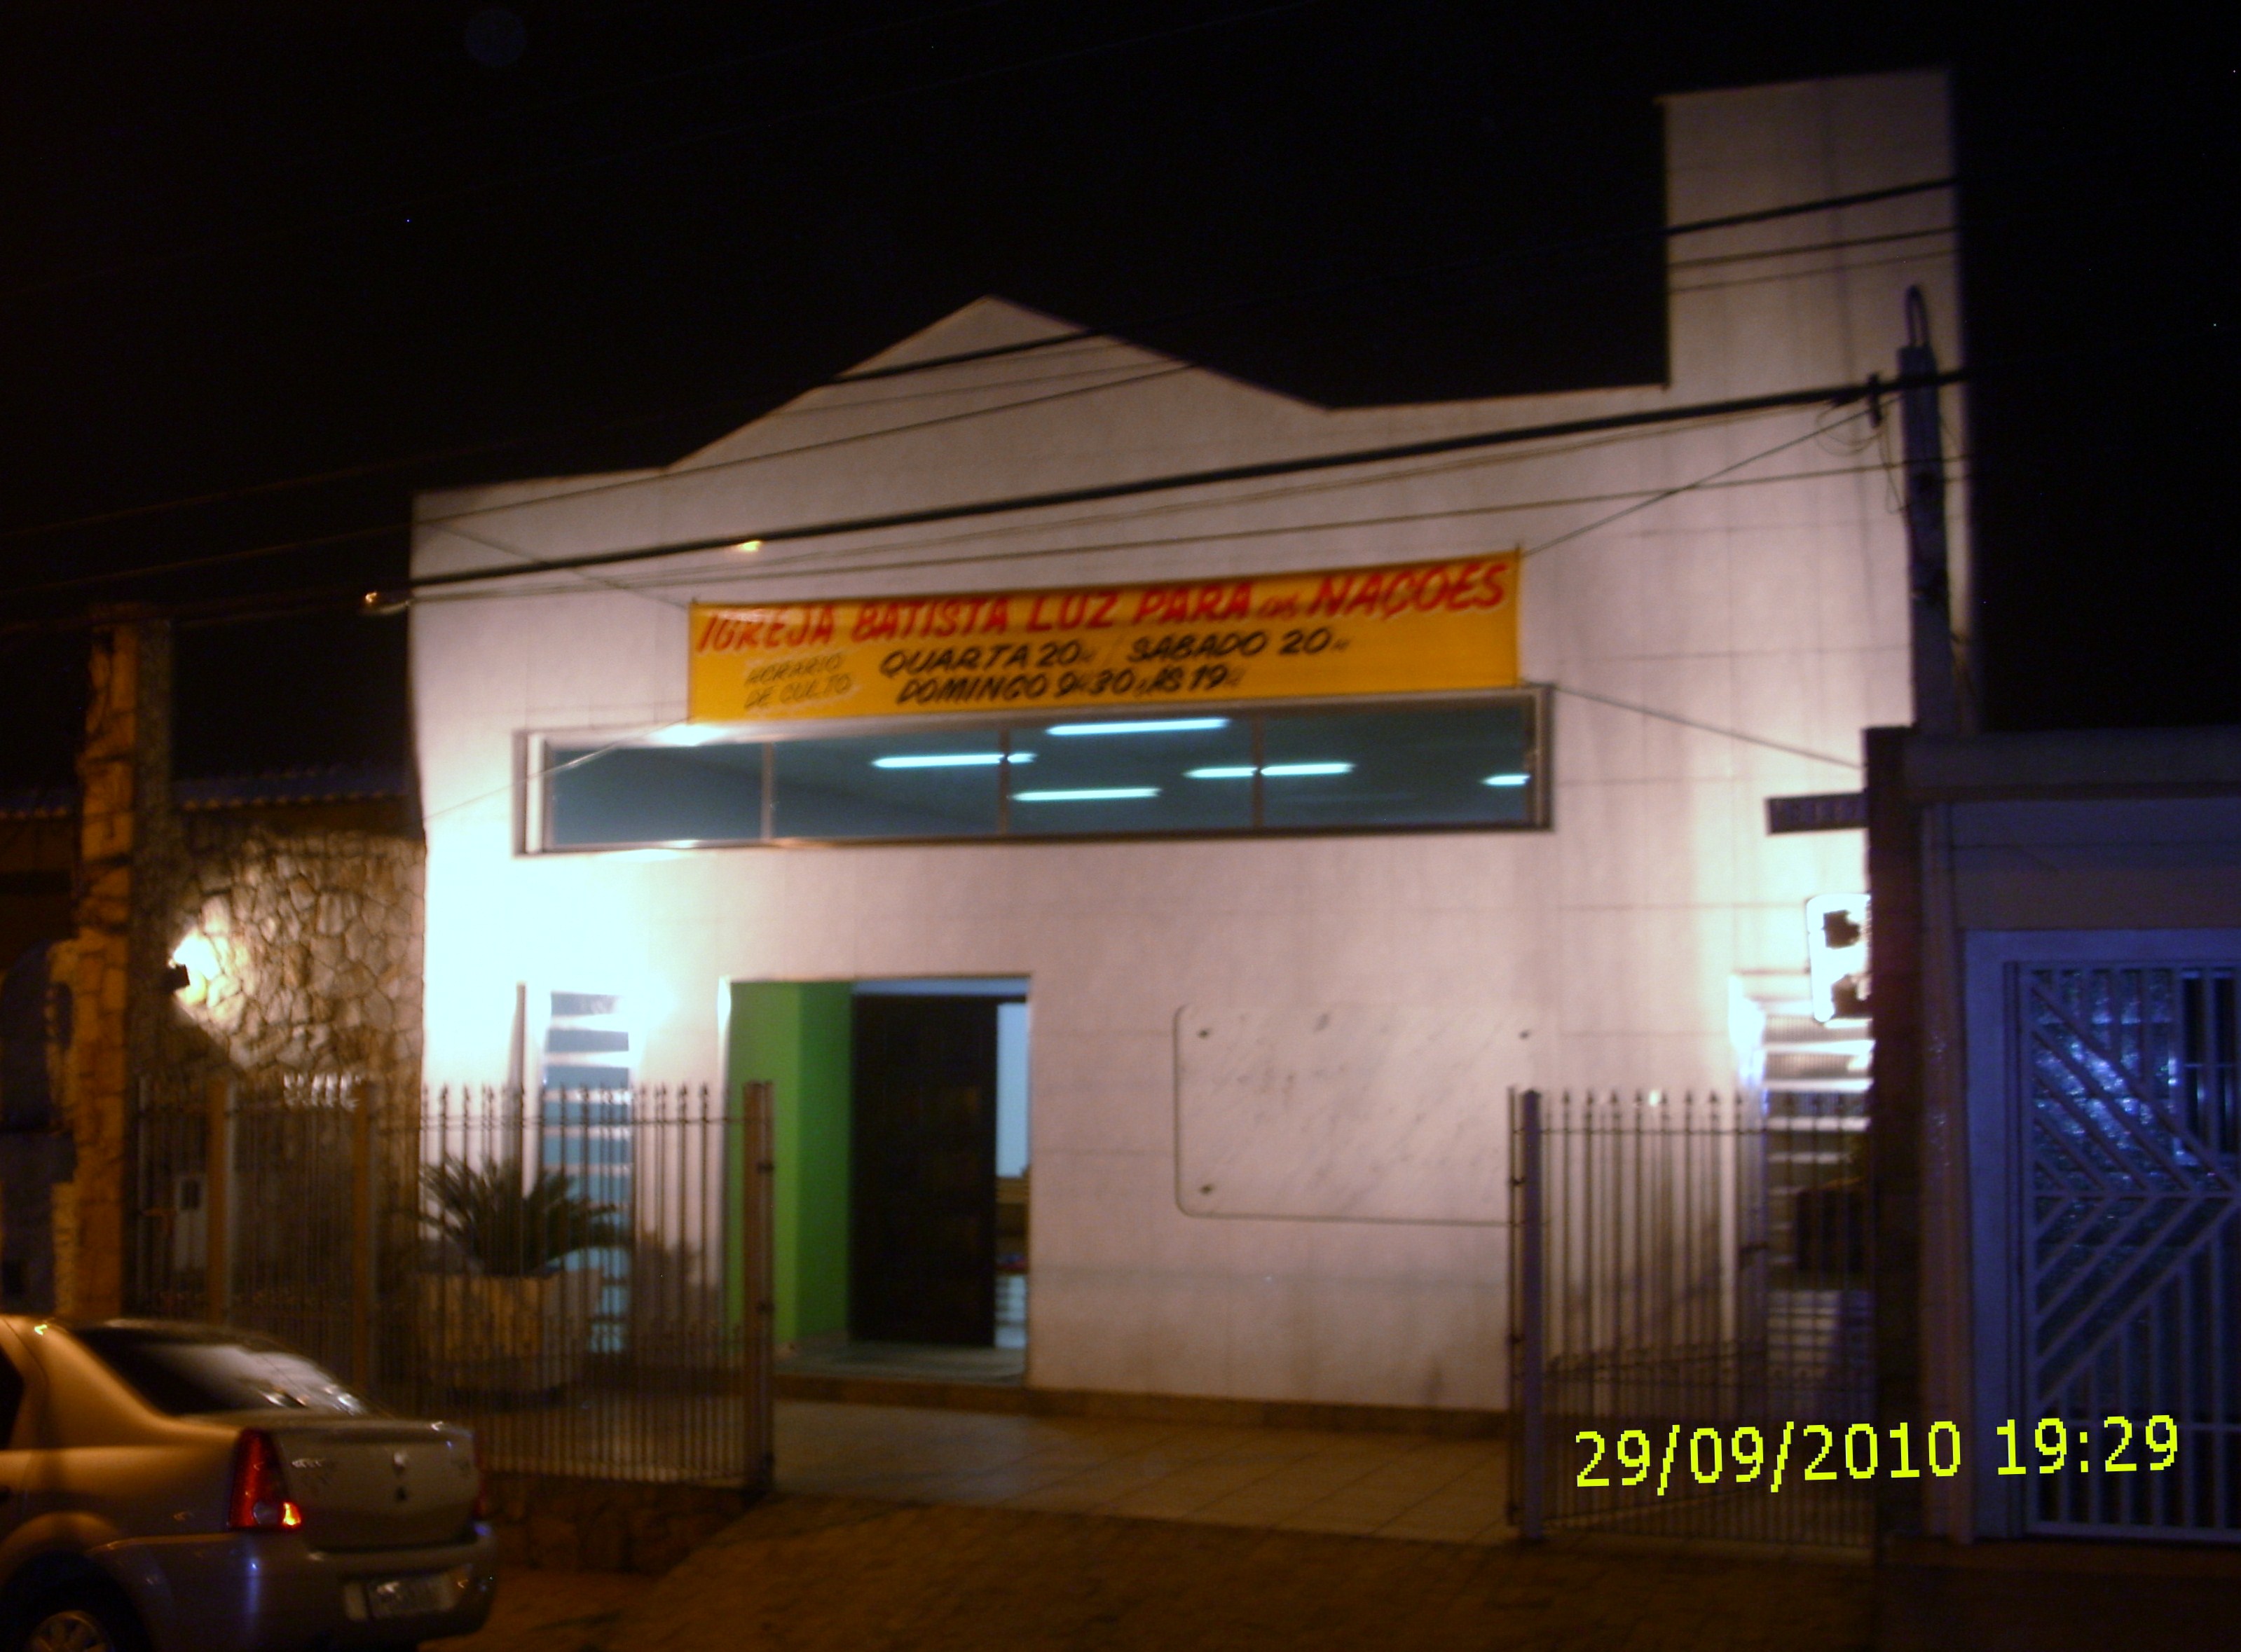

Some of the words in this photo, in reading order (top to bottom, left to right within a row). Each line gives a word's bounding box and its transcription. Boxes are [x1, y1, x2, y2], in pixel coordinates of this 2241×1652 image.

[696, 605, 835, 652] IGREJA
[851, 598, 1008, 642] BATISTA
[1027, 591, 1120, 631] LUZ
[1132, 582, 1254, 625] PARA
[879, 645, 1029, 678] QUARTA
[896, 674, 1048, 705] DOMINGO
